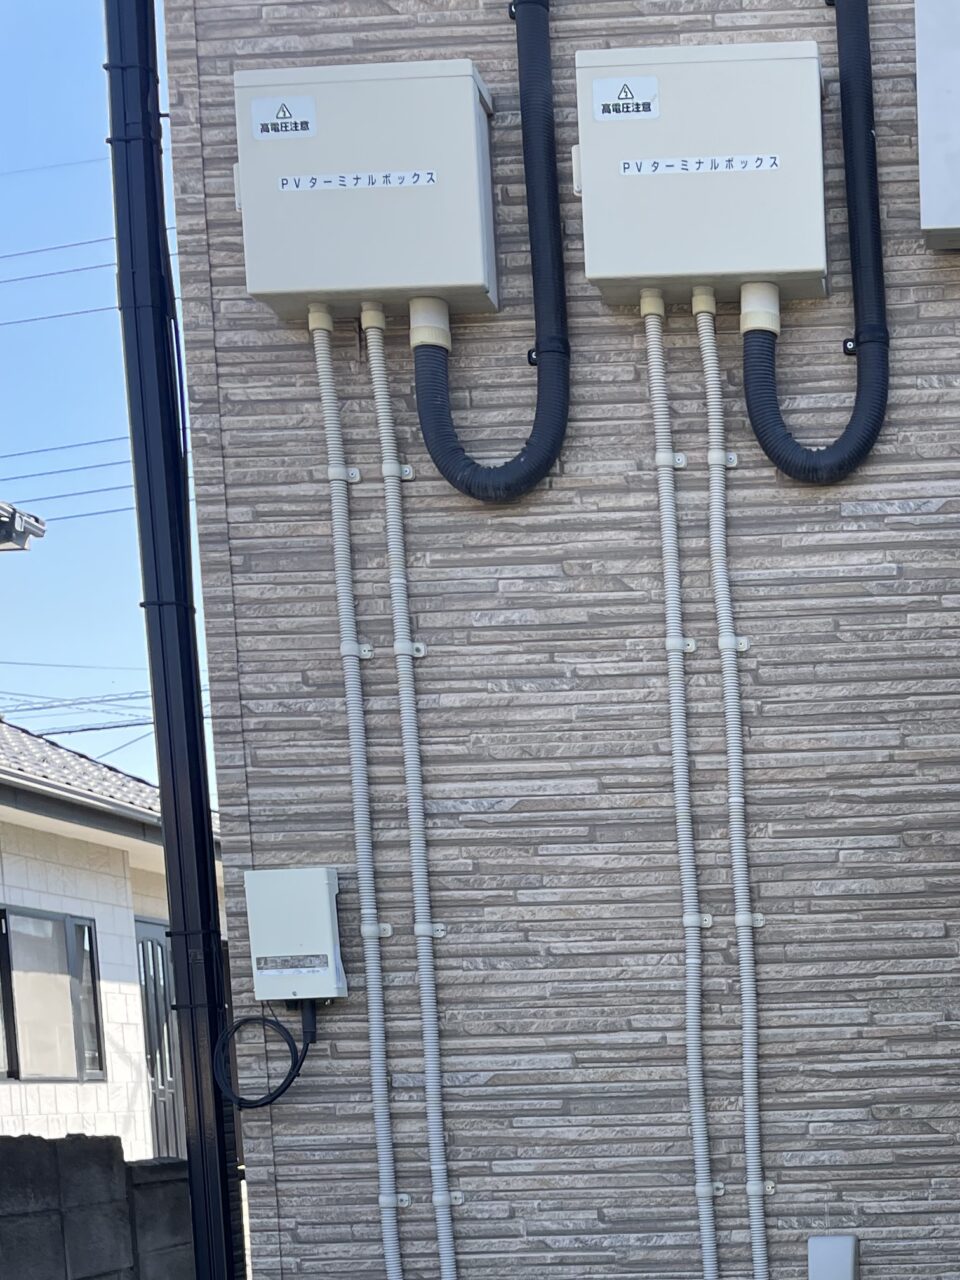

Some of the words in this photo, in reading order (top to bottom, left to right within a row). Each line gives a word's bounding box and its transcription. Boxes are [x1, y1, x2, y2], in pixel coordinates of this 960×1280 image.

[601, 101, 652, 115] 高電圧注意
[260, 120, 310, 134] 高電圧注意
